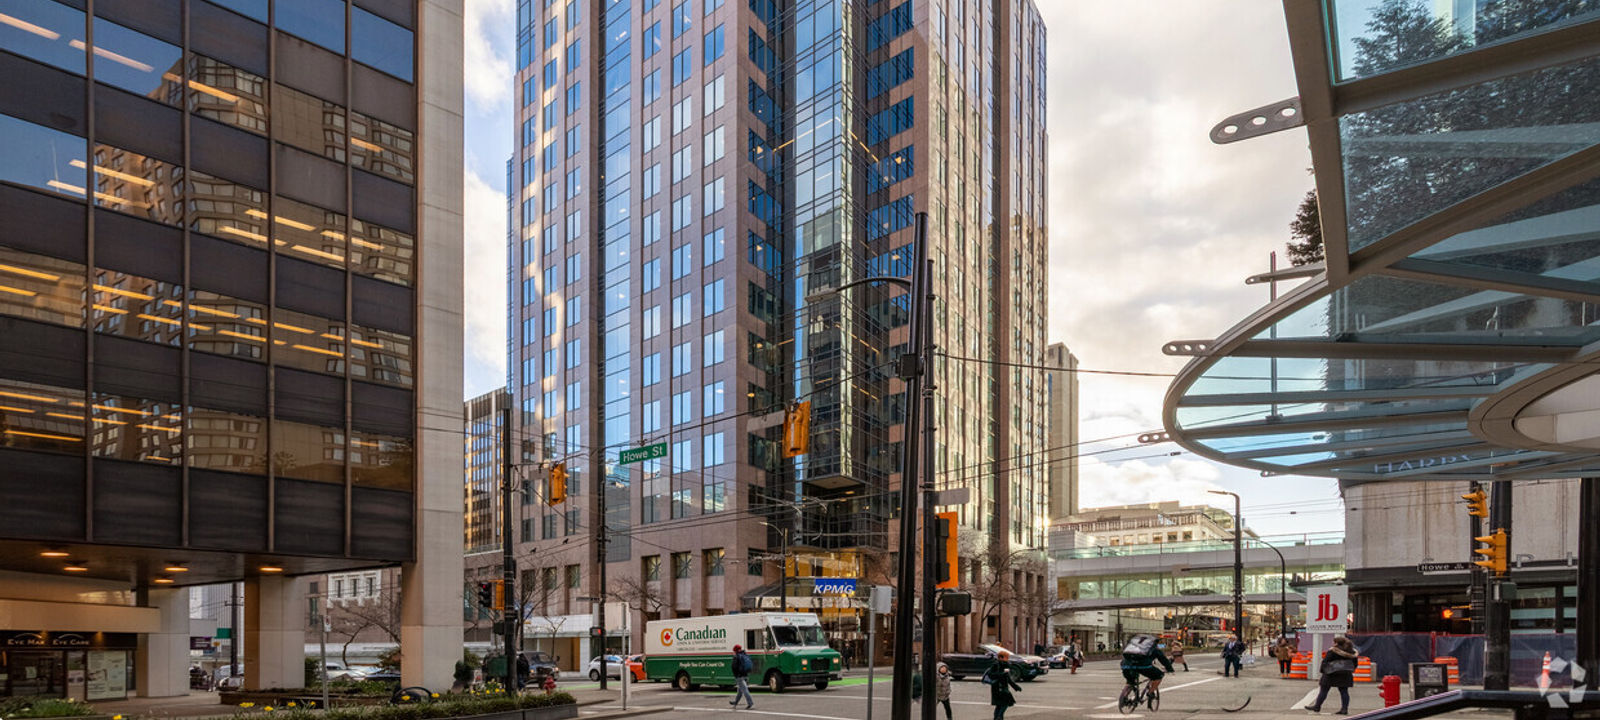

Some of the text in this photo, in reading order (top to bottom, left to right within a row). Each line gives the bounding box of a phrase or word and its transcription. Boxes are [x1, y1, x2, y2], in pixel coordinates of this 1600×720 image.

[623, 446, 663, 462] Howe St
[812, 584, 854, 594] KPMG
[1315, 593, 1339, 622] jb
[676, 625, 727, 640] Canadian
